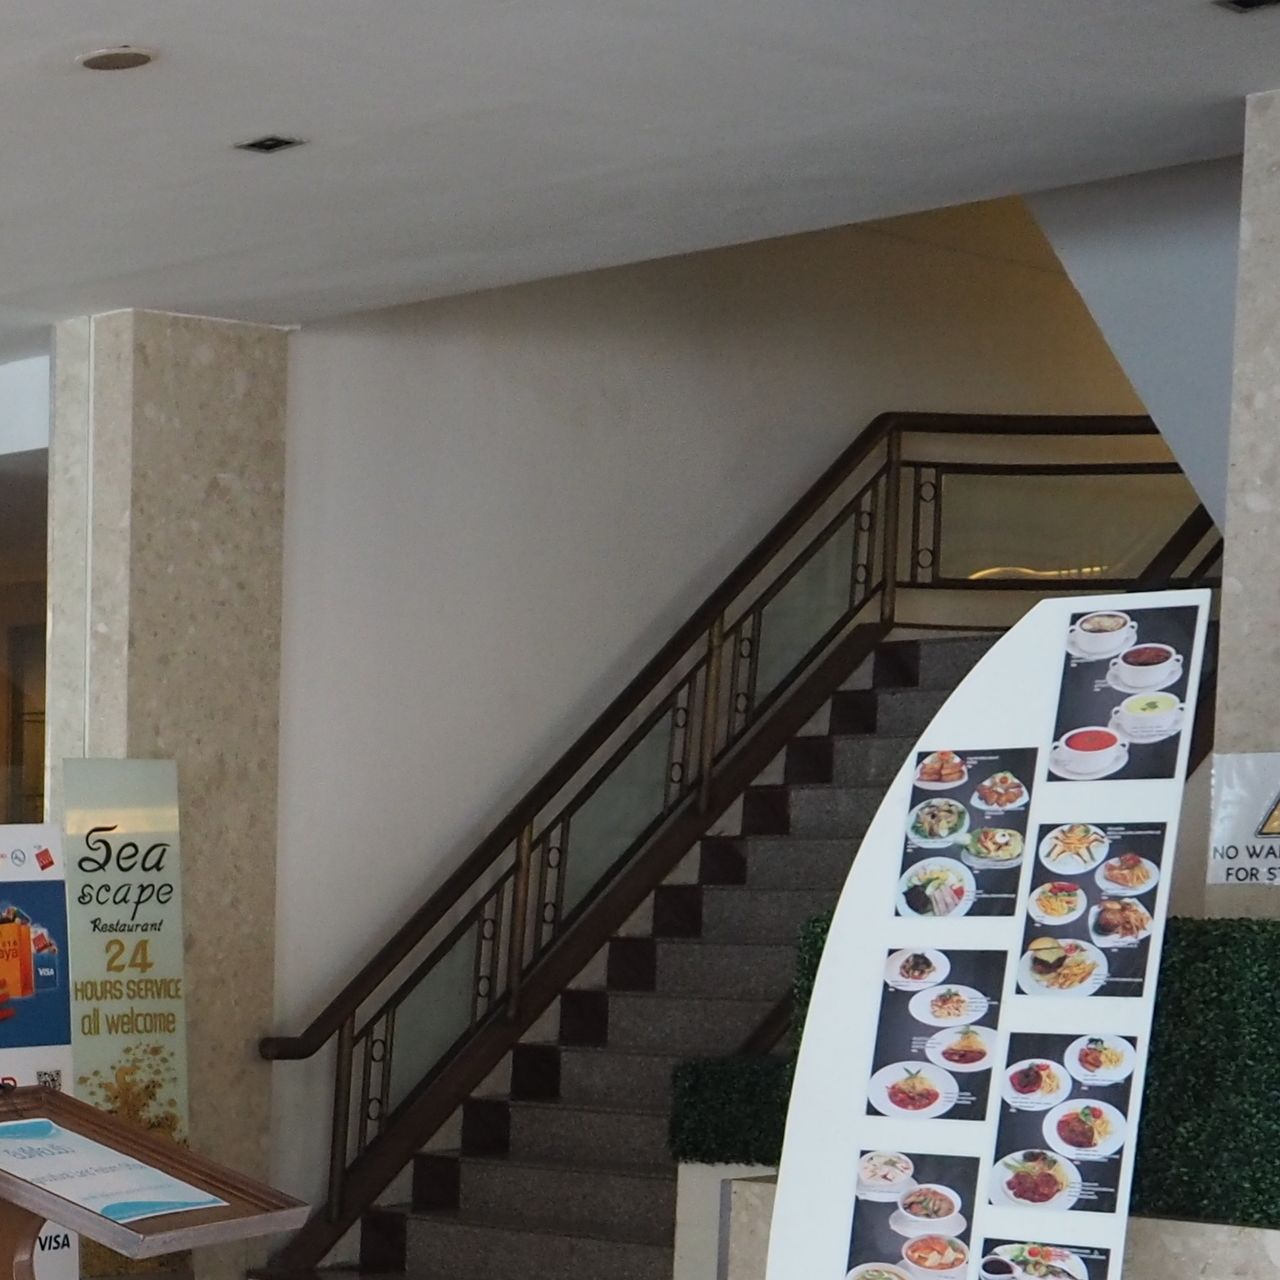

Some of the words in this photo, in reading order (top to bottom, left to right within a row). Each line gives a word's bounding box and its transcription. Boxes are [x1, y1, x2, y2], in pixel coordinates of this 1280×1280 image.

[78, 824, 171, 873] Sea
[1213, 845, 1239, 860] NO
[1226, 867, 1259, 882] FOR
[77, 882, 174, 921] scape
[91, 917, 163, 933] Restaurant
[105, 939, 154, 973] 24
[38, 968, 55, 977] VISA
[74, 979, 123, 1001] HOURS
[126, 978, 182, 1000] SERVICE
[81, 1007, 100, 1036] all
[105, 1006, 176, 1035] welcome
[38, 1234, 71, 1251] VISA
